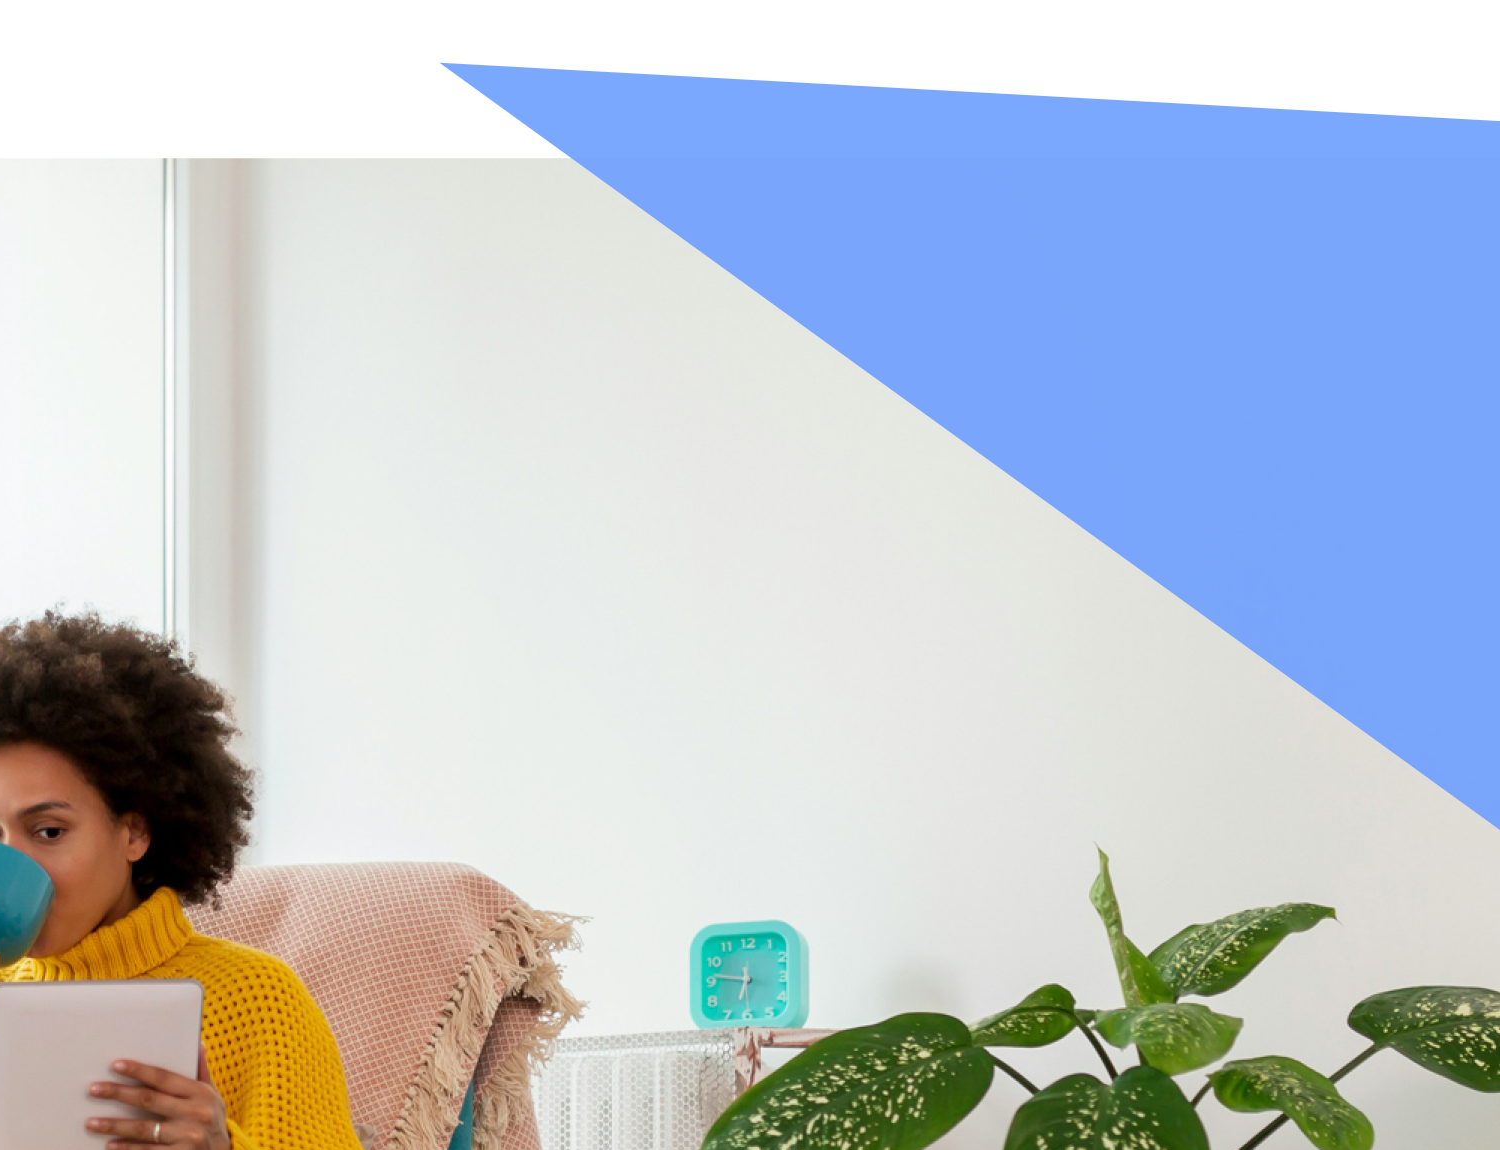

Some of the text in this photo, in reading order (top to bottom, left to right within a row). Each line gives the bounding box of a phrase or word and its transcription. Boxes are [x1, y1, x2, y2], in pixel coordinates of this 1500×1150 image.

[721, 941, 732, 952] 11
[741, 938, 756, 949] 12
[767, 939, 772, 950] 1
[707, 956, 722, 967] 10
[777, 951, 787, 963] 2
[706, 975, 717, 988] 9
[778, 970, 787, 982] 3
[707, 995, 718, 1007] 8
[776, 990, 787, 1002] 4
[722, 1009, 732, 1020] 7
[742, 1008, 753, 1020] 6
[764, 1006, 775, 1018] 5
